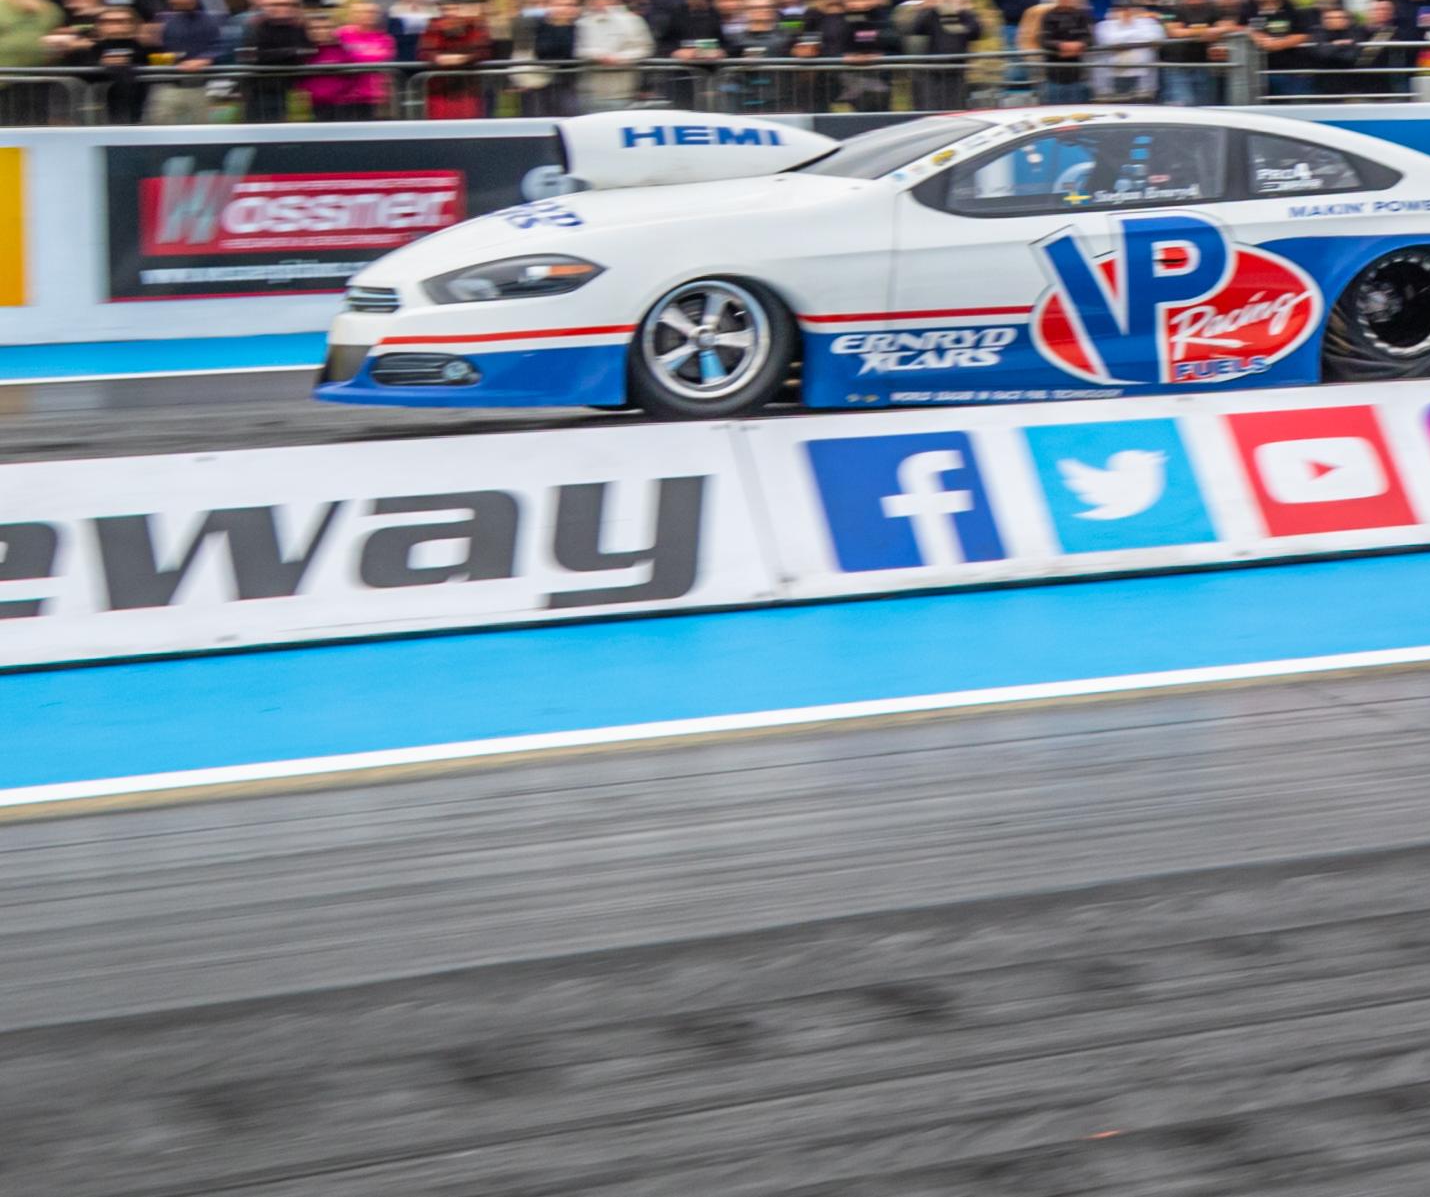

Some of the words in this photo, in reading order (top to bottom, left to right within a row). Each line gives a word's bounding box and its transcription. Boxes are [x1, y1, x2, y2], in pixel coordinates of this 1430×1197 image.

[622, 125, 784, 148] HEMI
[1038, 214, 1230, 383] VP
[1169, 290, 1316, 360] Racing
[829, 327, 1018, 354] ERNRYD
[1174, 355, 1270, 381] FUELS
